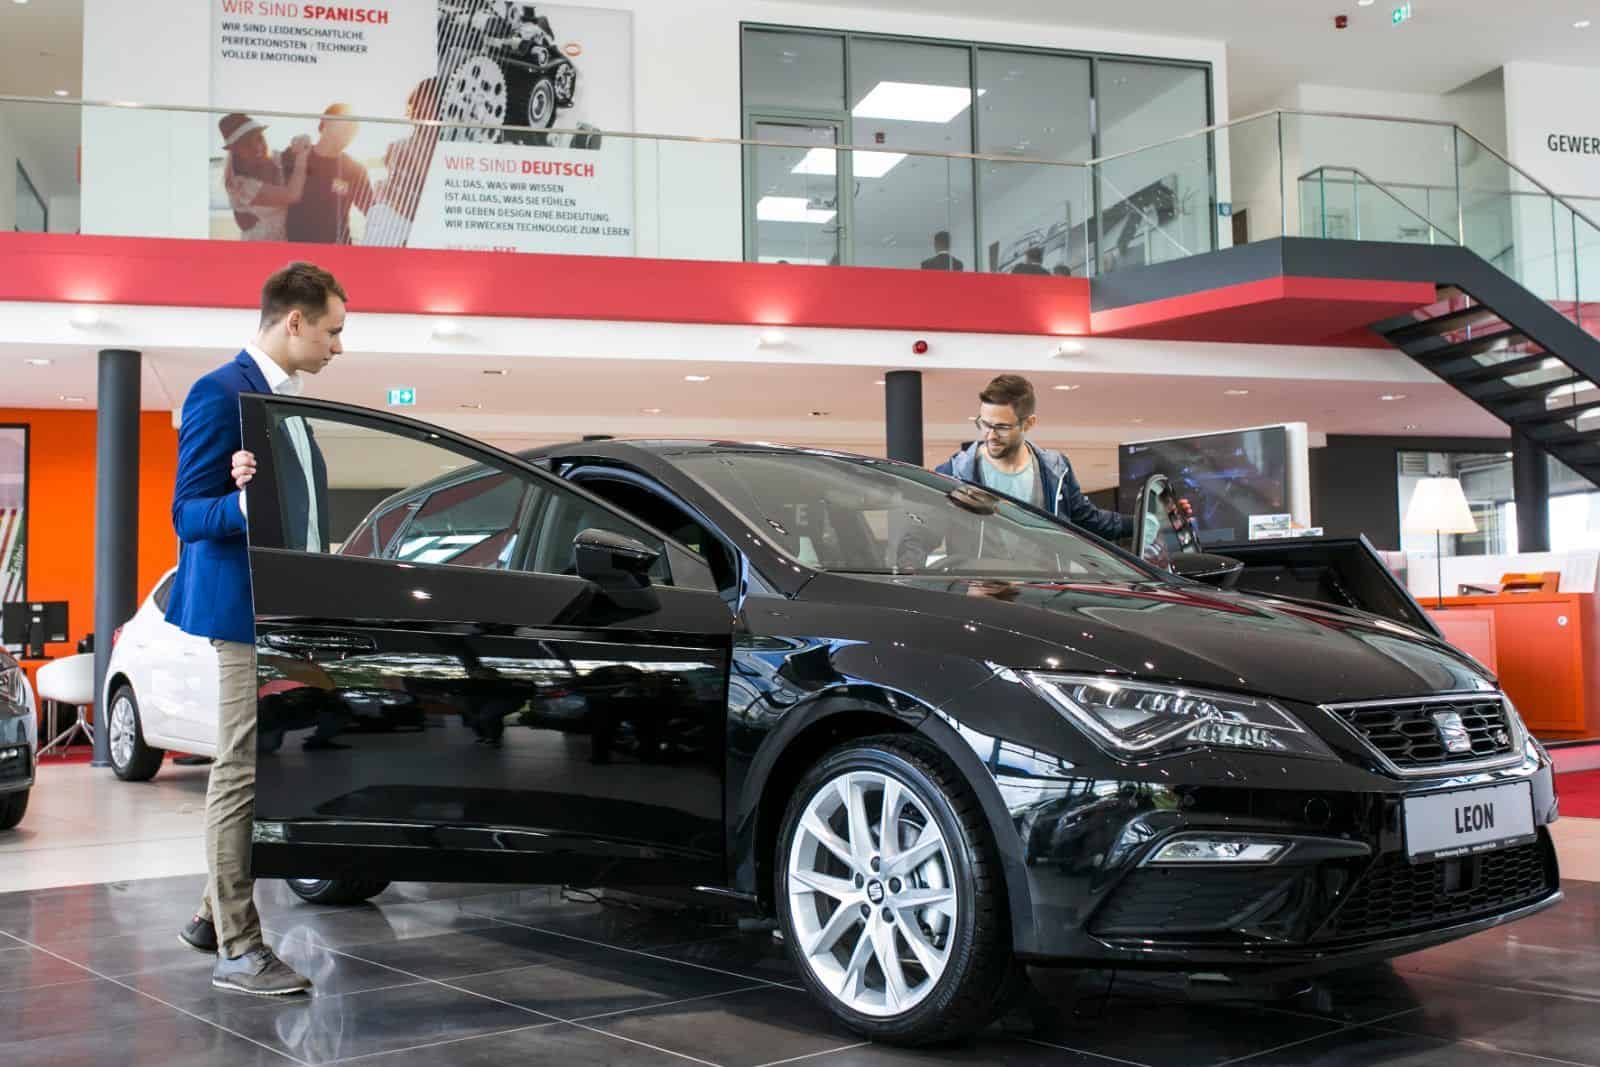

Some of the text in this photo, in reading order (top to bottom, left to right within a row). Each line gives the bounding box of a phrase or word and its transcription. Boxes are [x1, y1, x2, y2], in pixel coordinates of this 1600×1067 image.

[221, 0, 388, 24] WIR SIND SPANISCH
[222, 22, 364, 40] WIR SIND LEIDENSCHAFTLICHE
[222, 36, 307, 49] PERFEKTIONISTEN
[317, 42, 368, 53] TECHNIKER
[222, 50, 317, 64] VOLLER EMOTIONEN
[1547, 134, 1600, 154] GEWER
[445, 157, 595, 177] WIR SIND DEUTSCH
[445, 179, 461, 188] ALL
[487, 181, 508, 190] WAS
[510, 182, 527, 191] WIR
[529, 183, 564, 193] WISSEN
[445, 193, 459, 201] IST
[461, 193, 477, 202] ALL
[503, 196, 524, 205] WAS
[526, 197, 539, 206] SIE
[445, 206, 609, 222] WIR GEBEN DESIGN EINE BEDEUTUNG
[445, 220, 630, 237] WIR ERWECKEN TECHNOLOGIE ZUM LEBEN
[1455, 802, 1494, 834] LEON
